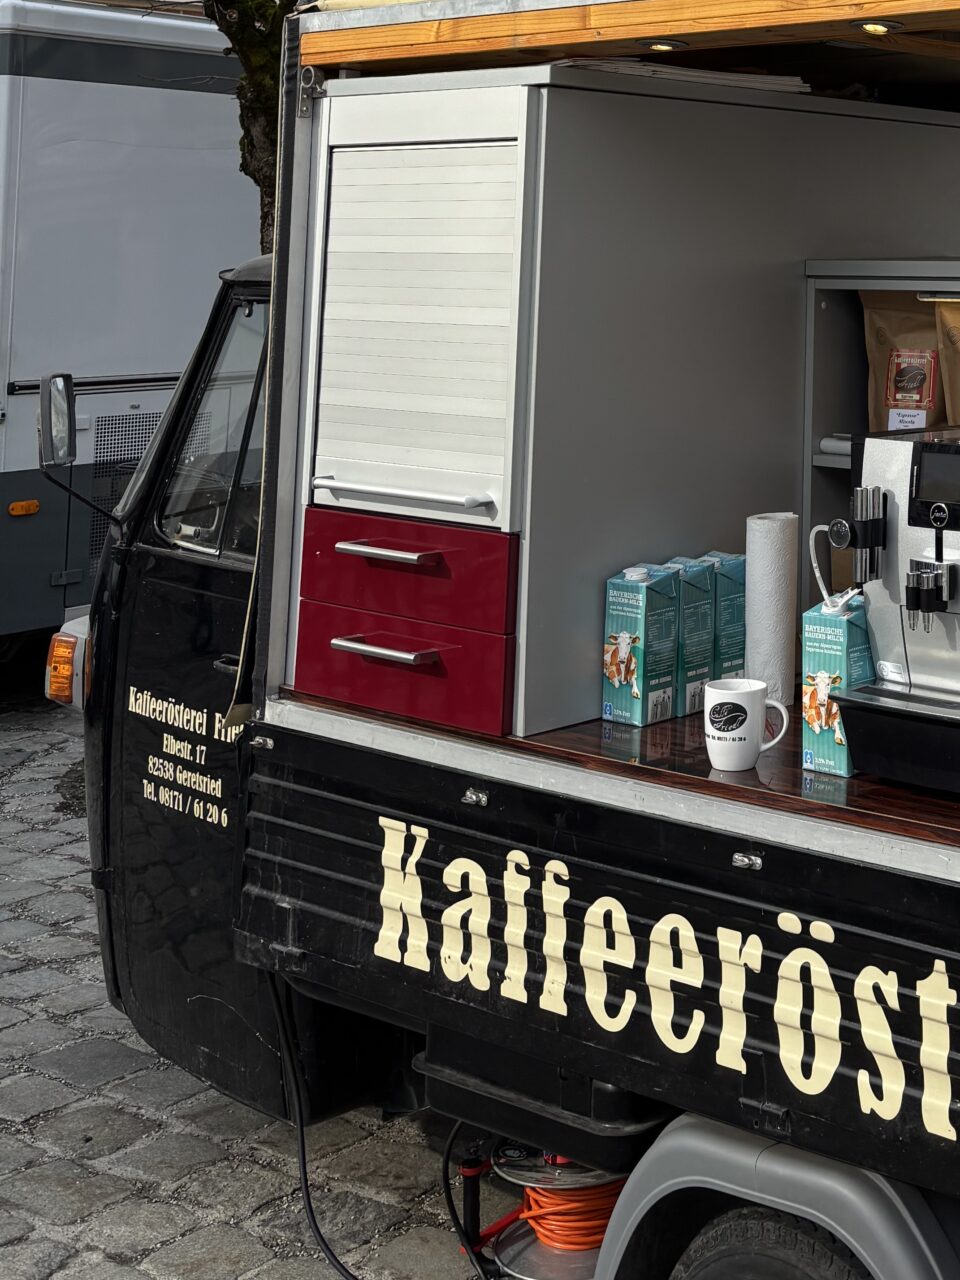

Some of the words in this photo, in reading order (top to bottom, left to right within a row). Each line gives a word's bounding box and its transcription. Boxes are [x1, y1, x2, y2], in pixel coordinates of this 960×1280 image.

[609, 589, 643, 601] BAYERISCHE
[805, 624, 843, 636] BAYERISCHE
[805, 631, 843, 642] BAUERN-MILCH
[128, 686, 207, 736] Kaffeerösterei
[713, 715, 742, 731] Friedl
[162, 733, 193, 762] Elbestr.
[196, 744, 207, 765] 17
[147, 755, 174, 782] 82538
[176, 765, 222, 798] Geretsried
[142, 778, 157, 802] Tel.
[158, 785, 183, 812] 08171
[185, 795, 192, 814] /
[193, 798, 204, 820] 61
[206, 802, 219, 824] 20
[221, 807, 228, 827] 6
